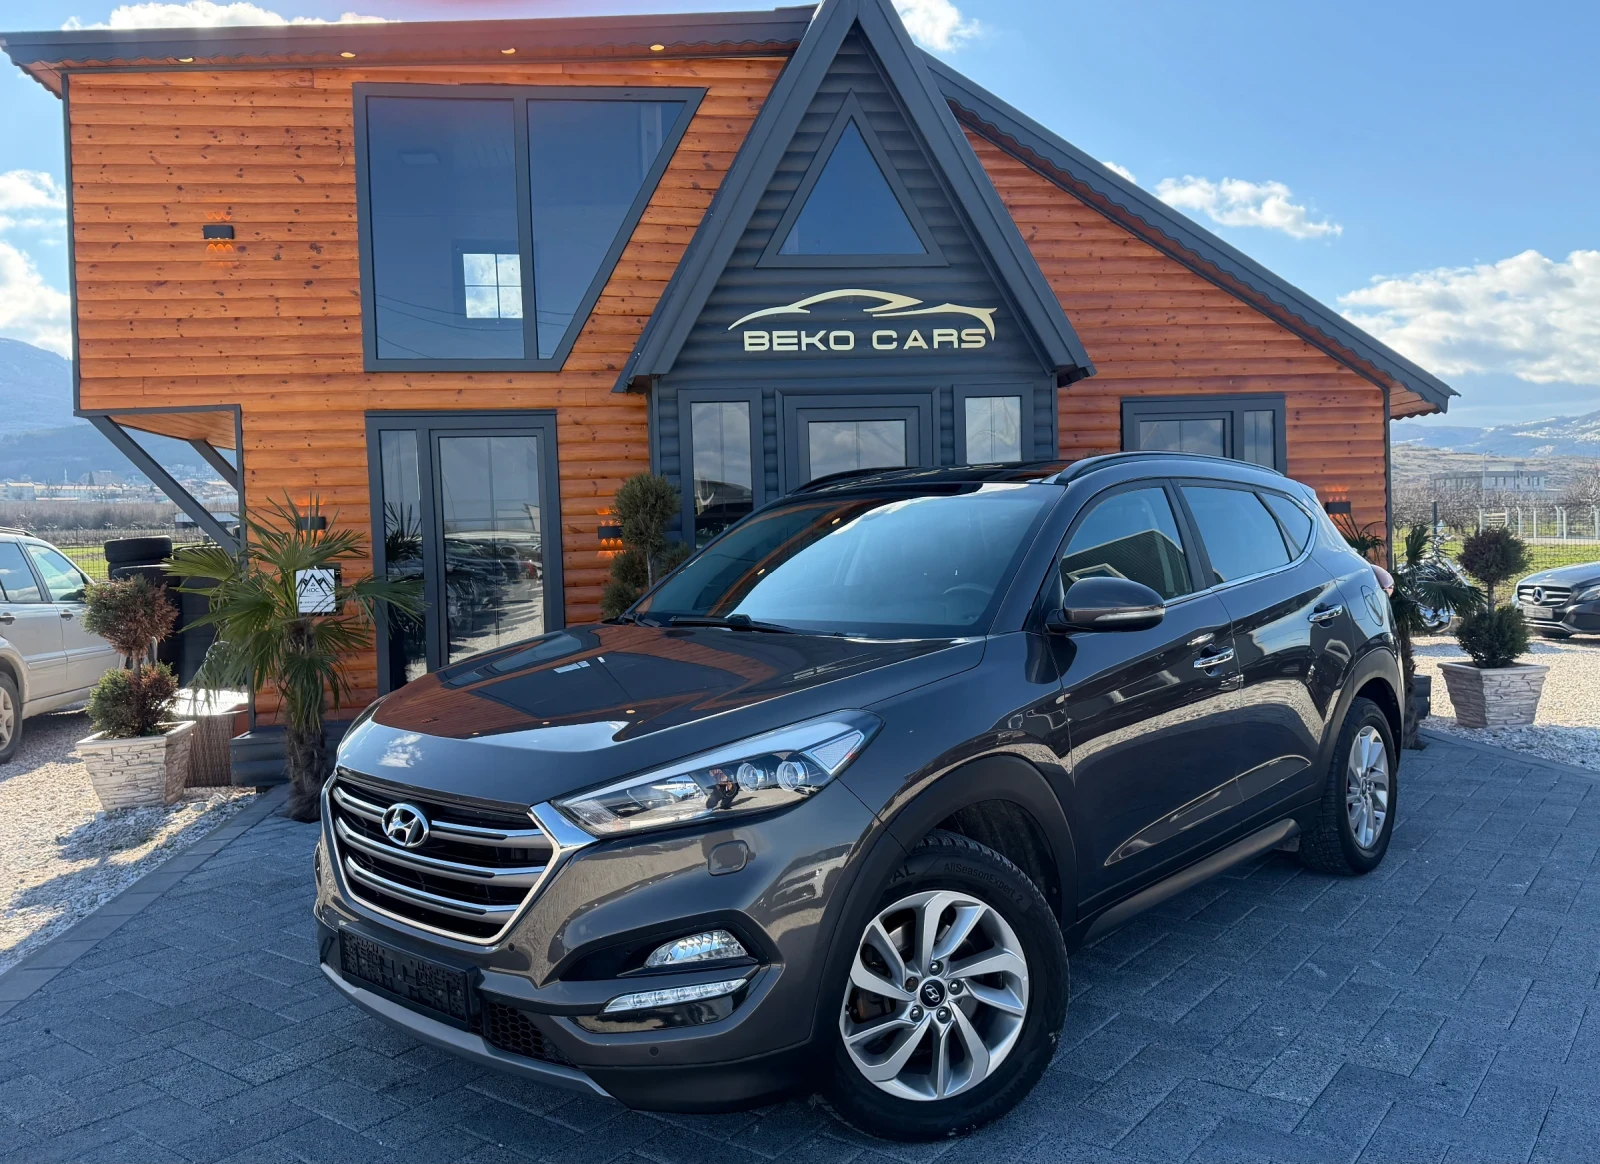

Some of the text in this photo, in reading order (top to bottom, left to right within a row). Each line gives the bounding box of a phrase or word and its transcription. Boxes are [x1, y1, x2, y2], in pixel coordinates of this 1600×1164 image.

[743, 328, 986, 351] BEKO CARS
[943, 862, 1024, 903] AllSeasonExpert 2
